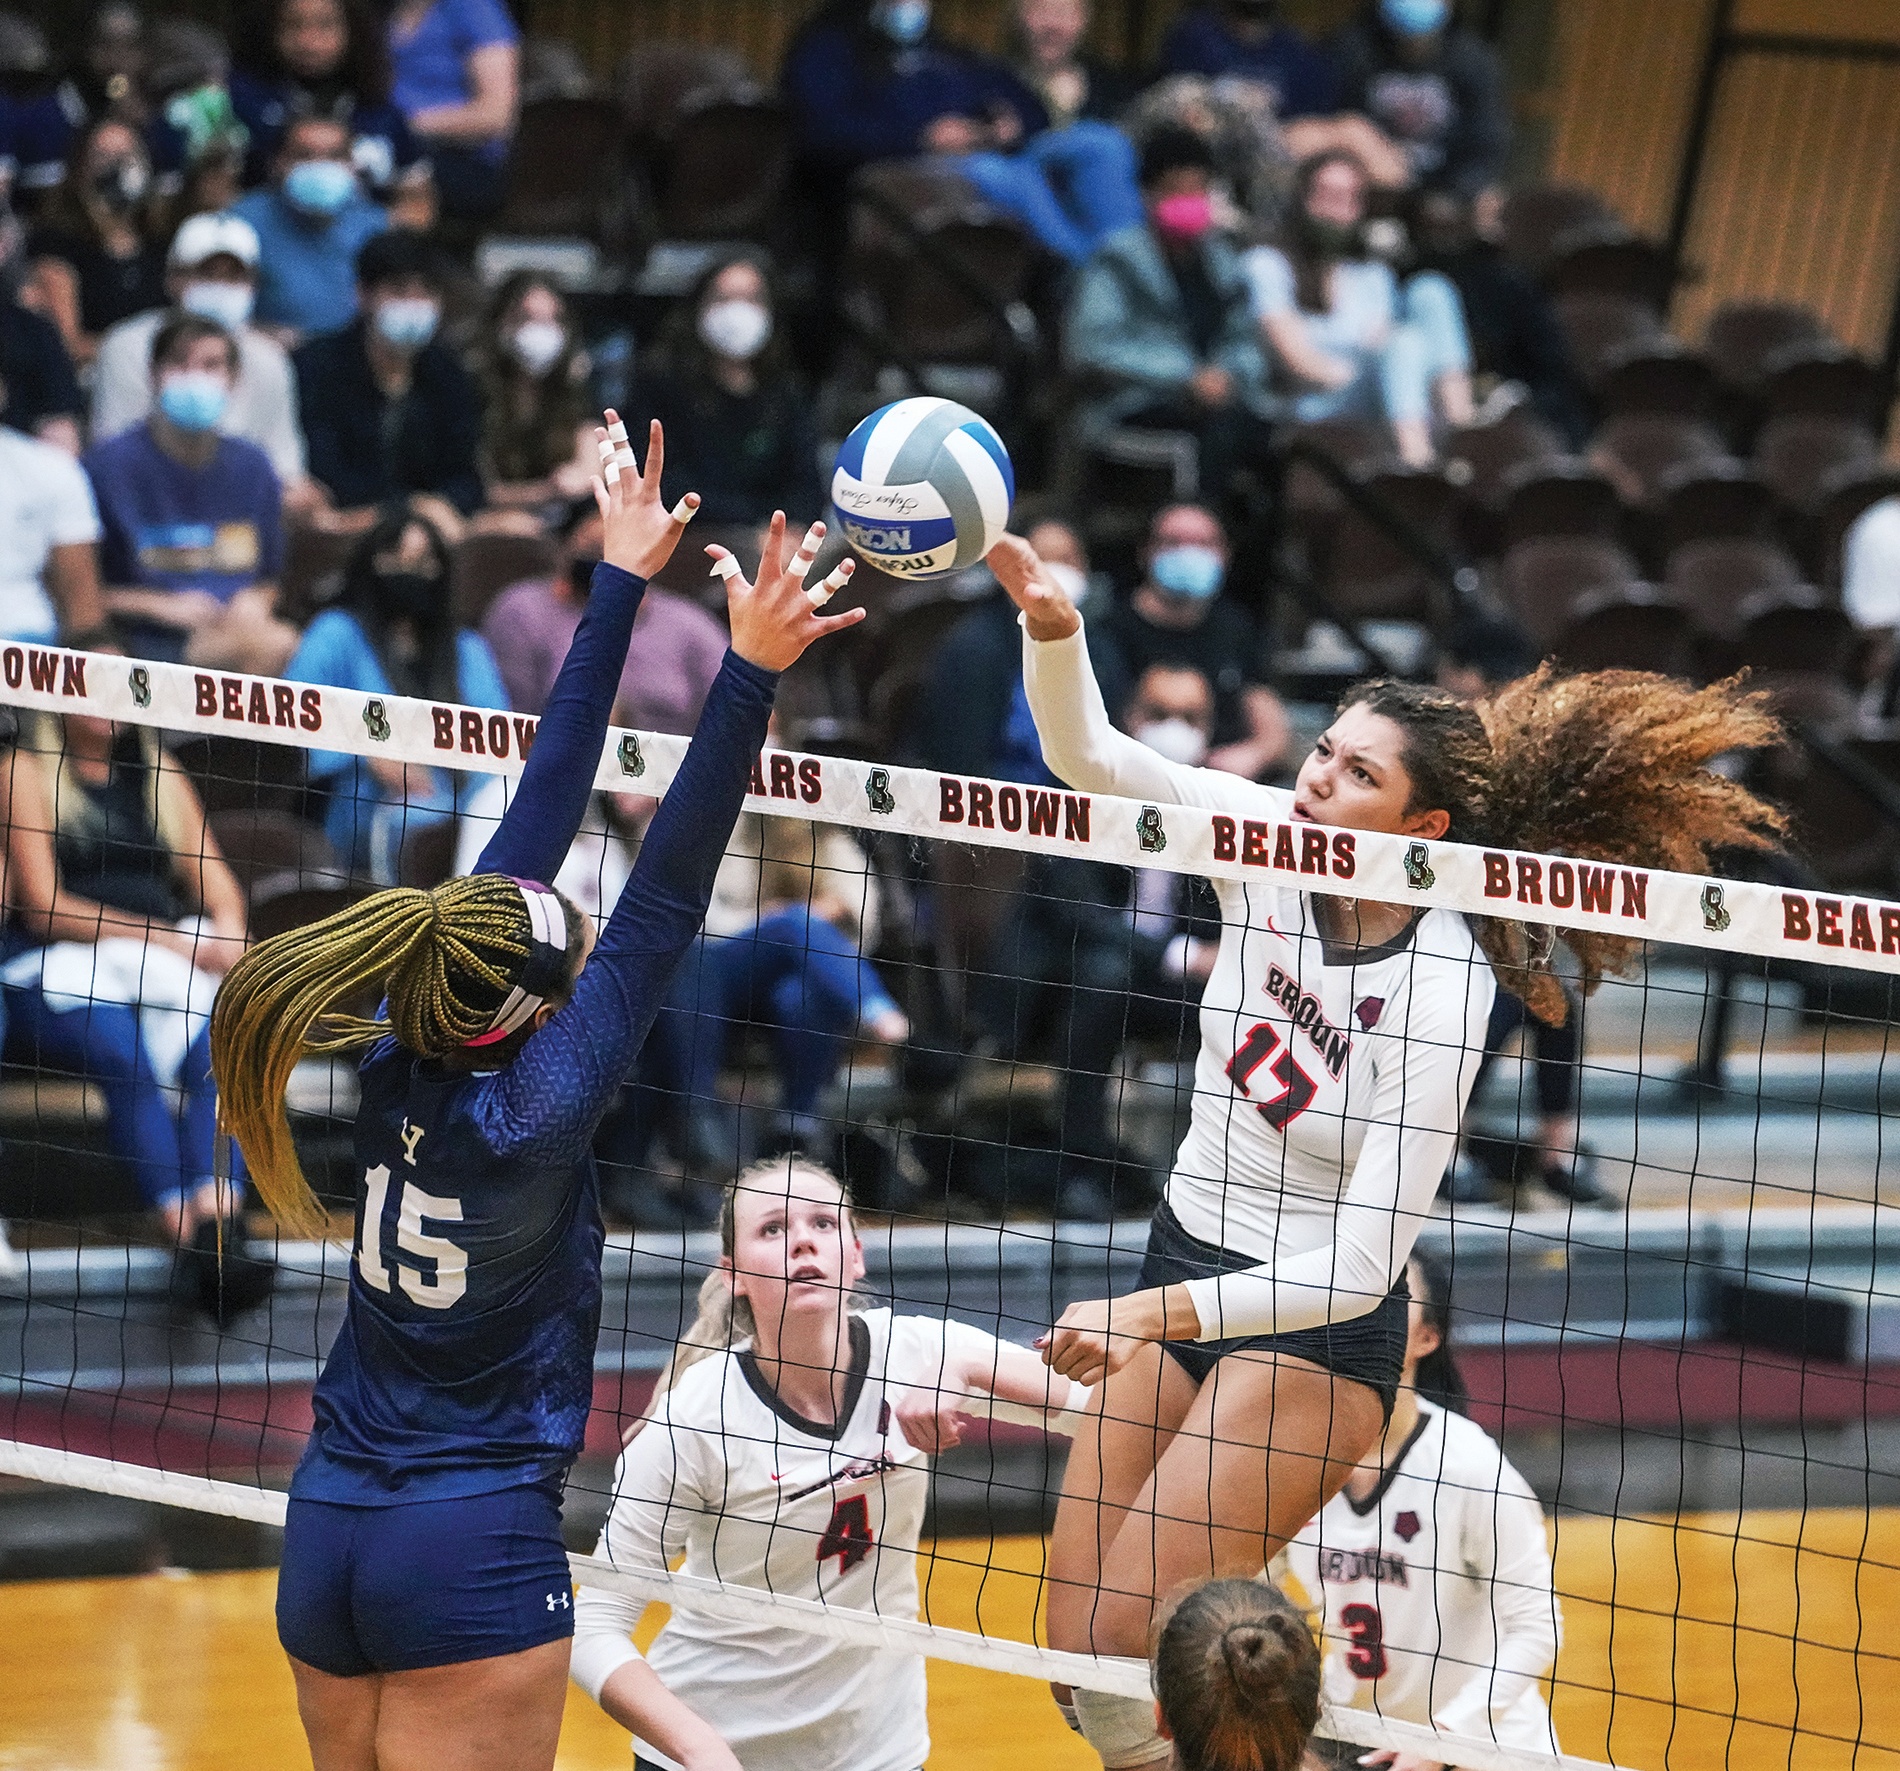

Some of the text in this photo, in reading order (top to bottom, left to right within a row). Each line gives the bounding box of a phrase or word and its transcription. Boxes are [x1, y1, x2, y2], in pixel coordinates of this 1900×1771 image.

[845, 519, 912, 551] NCAA
[876, 493, 919, 514] Super
[194, 674, 322, 732] BEARS
[939, 777, 1091, 843] BROWN
[1212, 815, 1356, 880] BEARS
[1483, 851, 1649, 920] BROWN
[1225, 1022, 1319, 1134] 17
[401, 1116, 425, 1166] Y
[358, 1163, 468, 1309] 15
[815, 1494, 873, 1576] 4
[1340, 1603, 1388, 1680] 3
